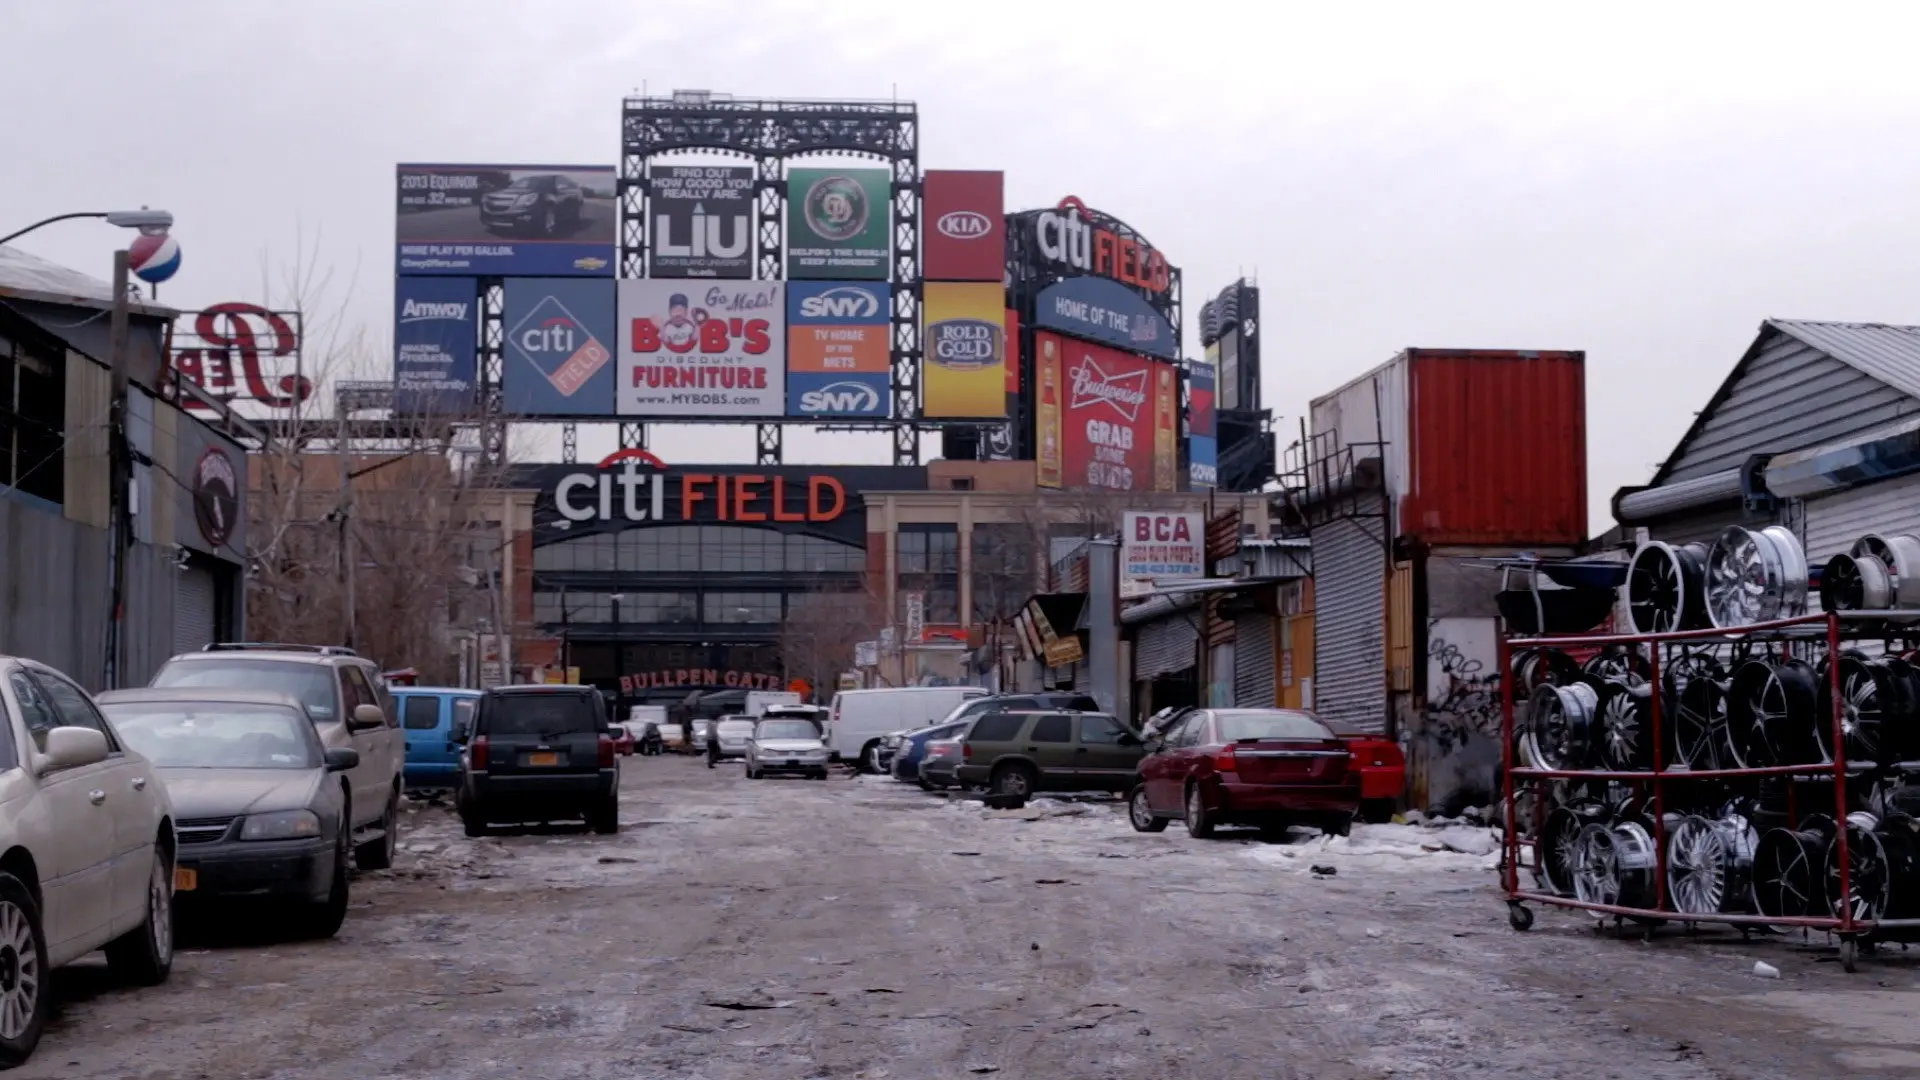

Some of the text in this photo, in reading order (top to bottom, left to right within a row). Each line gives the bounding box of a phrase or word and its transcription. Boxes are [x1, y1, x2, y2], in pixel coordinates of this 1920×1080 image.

[402, 175, 428, 189] 2013
[673, 168, 732, 178] FIND OUT
[652, 179, 754, 190] HOW GOOD YOU
[663, 189, 710, 199] REALLY
[947, 217, 983, 232] KIA
[656, 214, 749, 259] LIU
[1094, 228, 1170, 293] FIELD
[704, 286, 728, 307] Go
[800, 294, 870, 317] SNY
[402, 299, 468, 320] Amway
[1056, 296, 1088, 321] HOME
[1091, 306, 1105, 325] OF
[1107, 311, 1129, 333] THE
[522, 324, 574, 353] citi
[814, 330, 865, 341] TV HOME
[942, 326, 990, 340] ROLD
[656, 356, 745, 364] DISCOUNT
[937, 340, 992, 359] GOLD
[557, 346, 601, 389] FIELD
[632, 366, 768, 389] FURNITURE
[637, 393, 760, 404] www.MYBOBS.com
[800, 389, 870, 412] SNY
[1086, 419, 1133, 449] GRAB
[555, 464, 846, 522] citi FIELD
[1135, 515, 1190, 541] BCA
[619, 668, 780, 693] BULLPEN GATE
